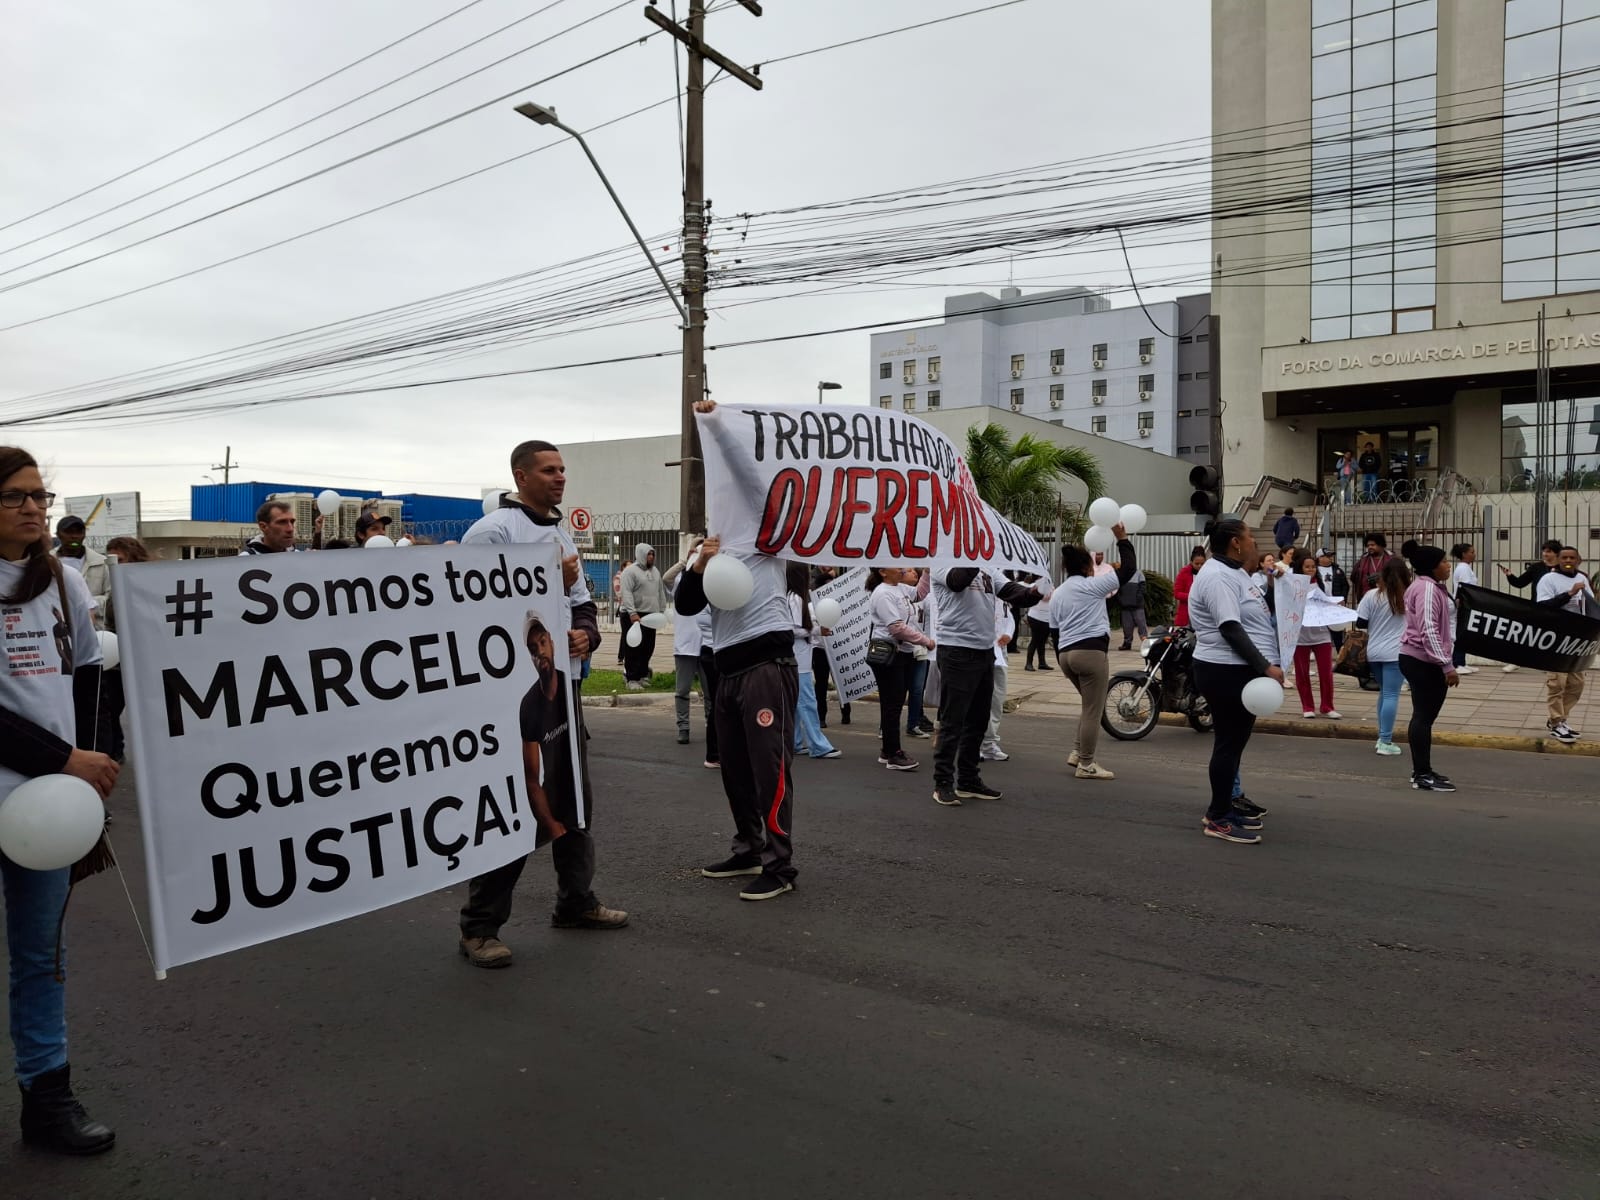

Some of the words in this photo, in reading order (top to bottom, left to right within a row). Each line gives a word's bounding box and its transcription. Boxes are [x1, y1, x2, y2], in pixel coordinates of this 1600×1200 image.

[1281, 359, 1333, 375] FORO
[1338, 356, 1363, 371] DA
[1369, 345, 1465, 367] COMARCA
[1472, 342, 1497, 358] DE
[755, 465, 995, 561] QUEREMOS
[165, 578, 213, 637] #
[238, 569, 434, 625] Somos
[445, 554, 548, 603] todos
[816, 587, 833, 599] Pode
[841, 602, 859, 616] tentes
[1467, 609, 1557, 650] ETERNO
[832, 637, 850, 649] deve
[836, 652, 849, 661] em
[850, 645, 863, 656] que
[162, 625, 516, 737] MARCELO
[839, 665, 850, 674] de
[843, 670, 870, 686] Justiça
[846, 680, 878, 698] Marcelo
[200, 724, 500, 819] Queremos
[191, 775, 521, 925] JUSTIÇA!
